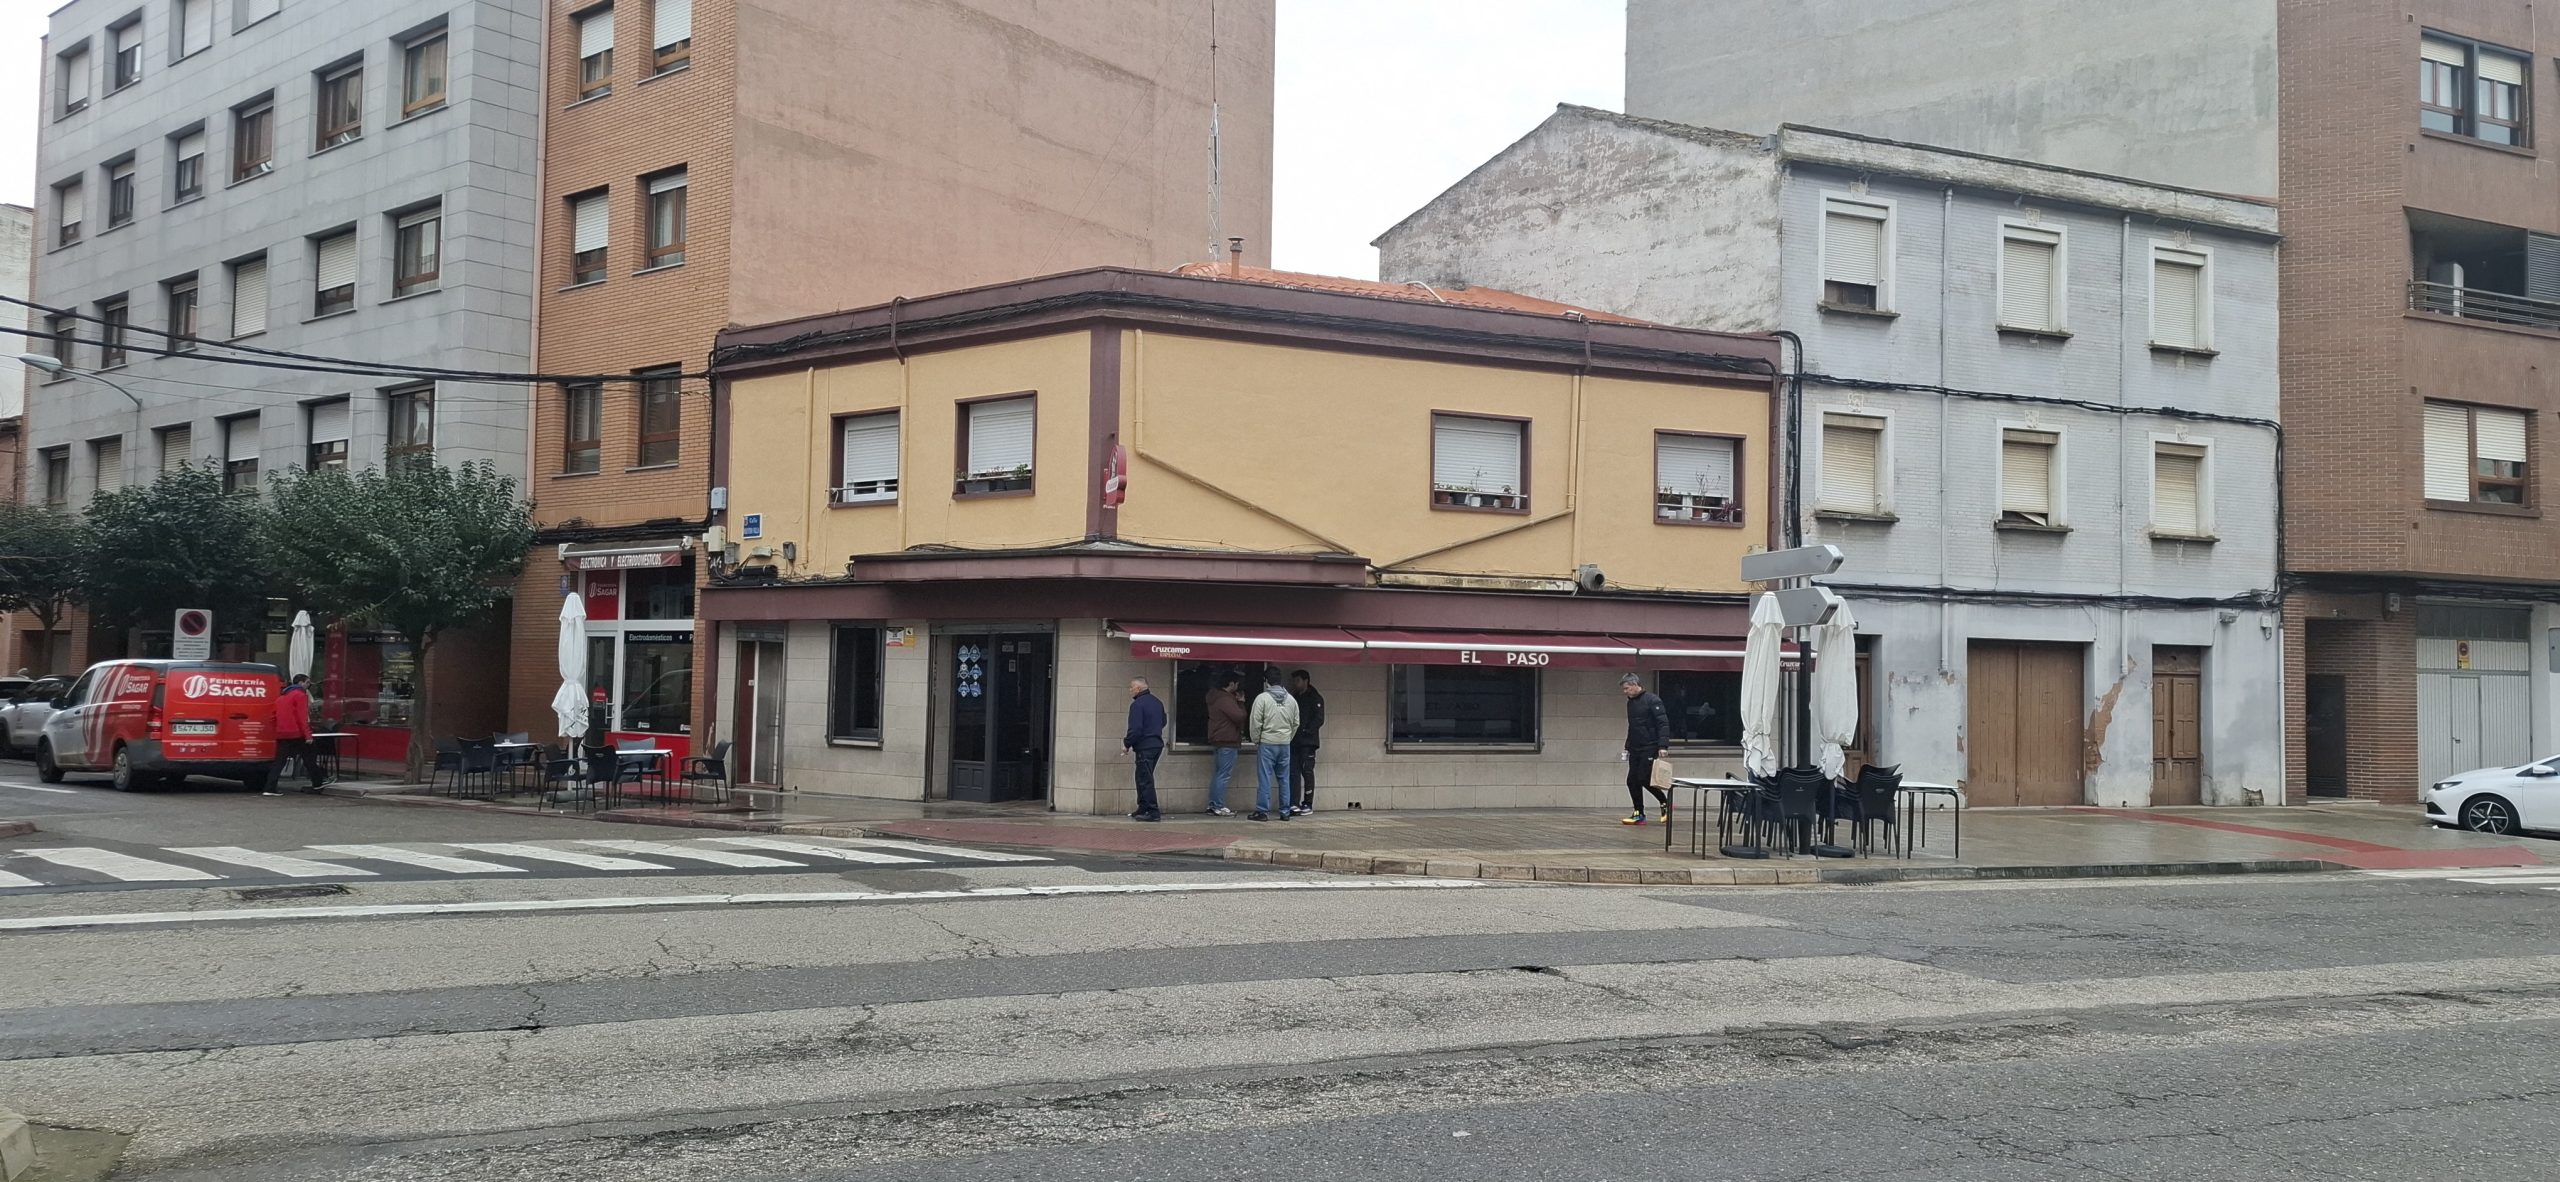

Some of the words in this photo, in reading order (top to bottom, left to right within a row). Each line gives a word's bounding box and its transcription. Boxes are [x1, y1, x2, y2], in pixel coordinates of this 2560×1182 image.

[597, 587, 617, 596] SAGAR
[1151, 644, 1191, 654] Cruzcampo
[1461, 650, 1482, 664] EL
[1506, 652, 1549, 666] PASO
[126, 682, 149, 693] SAGAR
[208, 684, 266, 698] SAGAR
